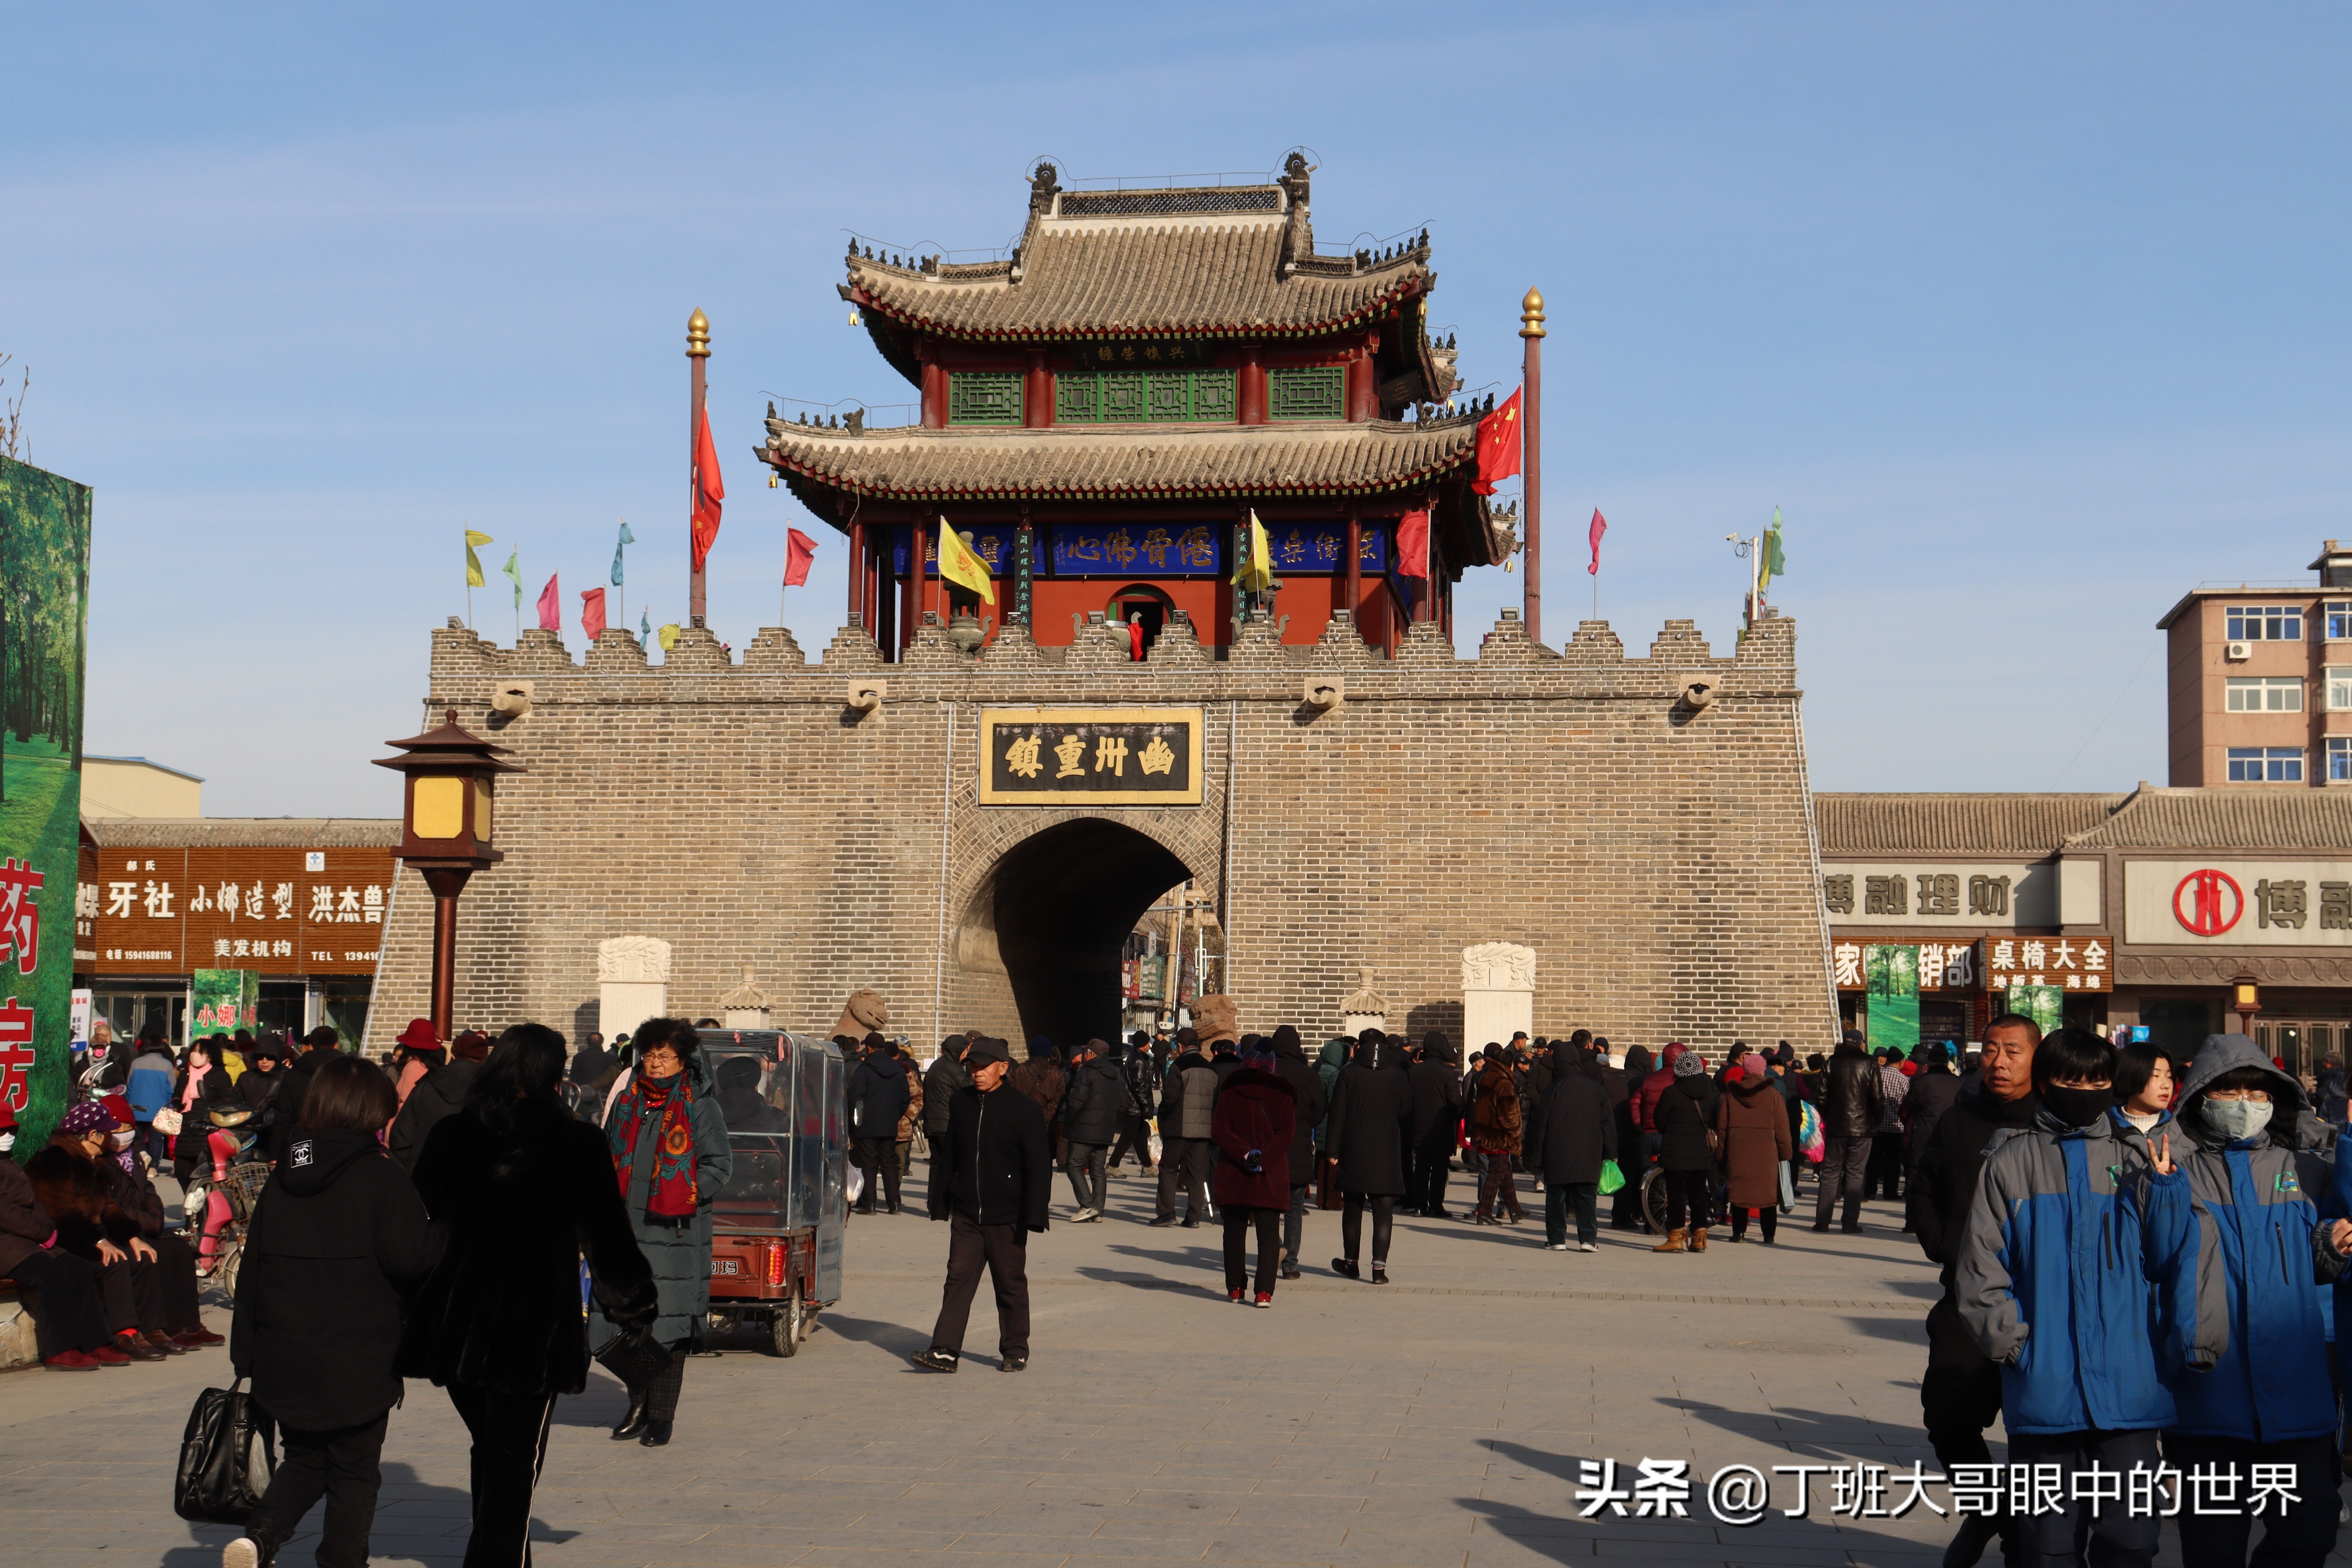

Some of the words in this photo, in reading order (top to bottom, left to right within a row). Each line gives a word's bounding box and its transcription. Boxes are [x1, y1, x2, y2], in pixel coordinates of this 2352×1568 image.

[126, 860, 156, 871] 郝氏
[105, 879, 175, 918] 牙社
[190, 880, 293, 923] 小娜造型
[308, 885, 391, 923] 洪杰兽
[106, 949, 122, 960] 电话
[214, 939, 292, 957] 美发机构
[311, 951, 333, 961] TEL
[1992, 940, 2107, 970] 桌椅大全
[1835, 942, 1973, 987] 家销部
[2067, 975, 2100, 989] 海绵
[197, 1004, 236, 1028] 小娜
